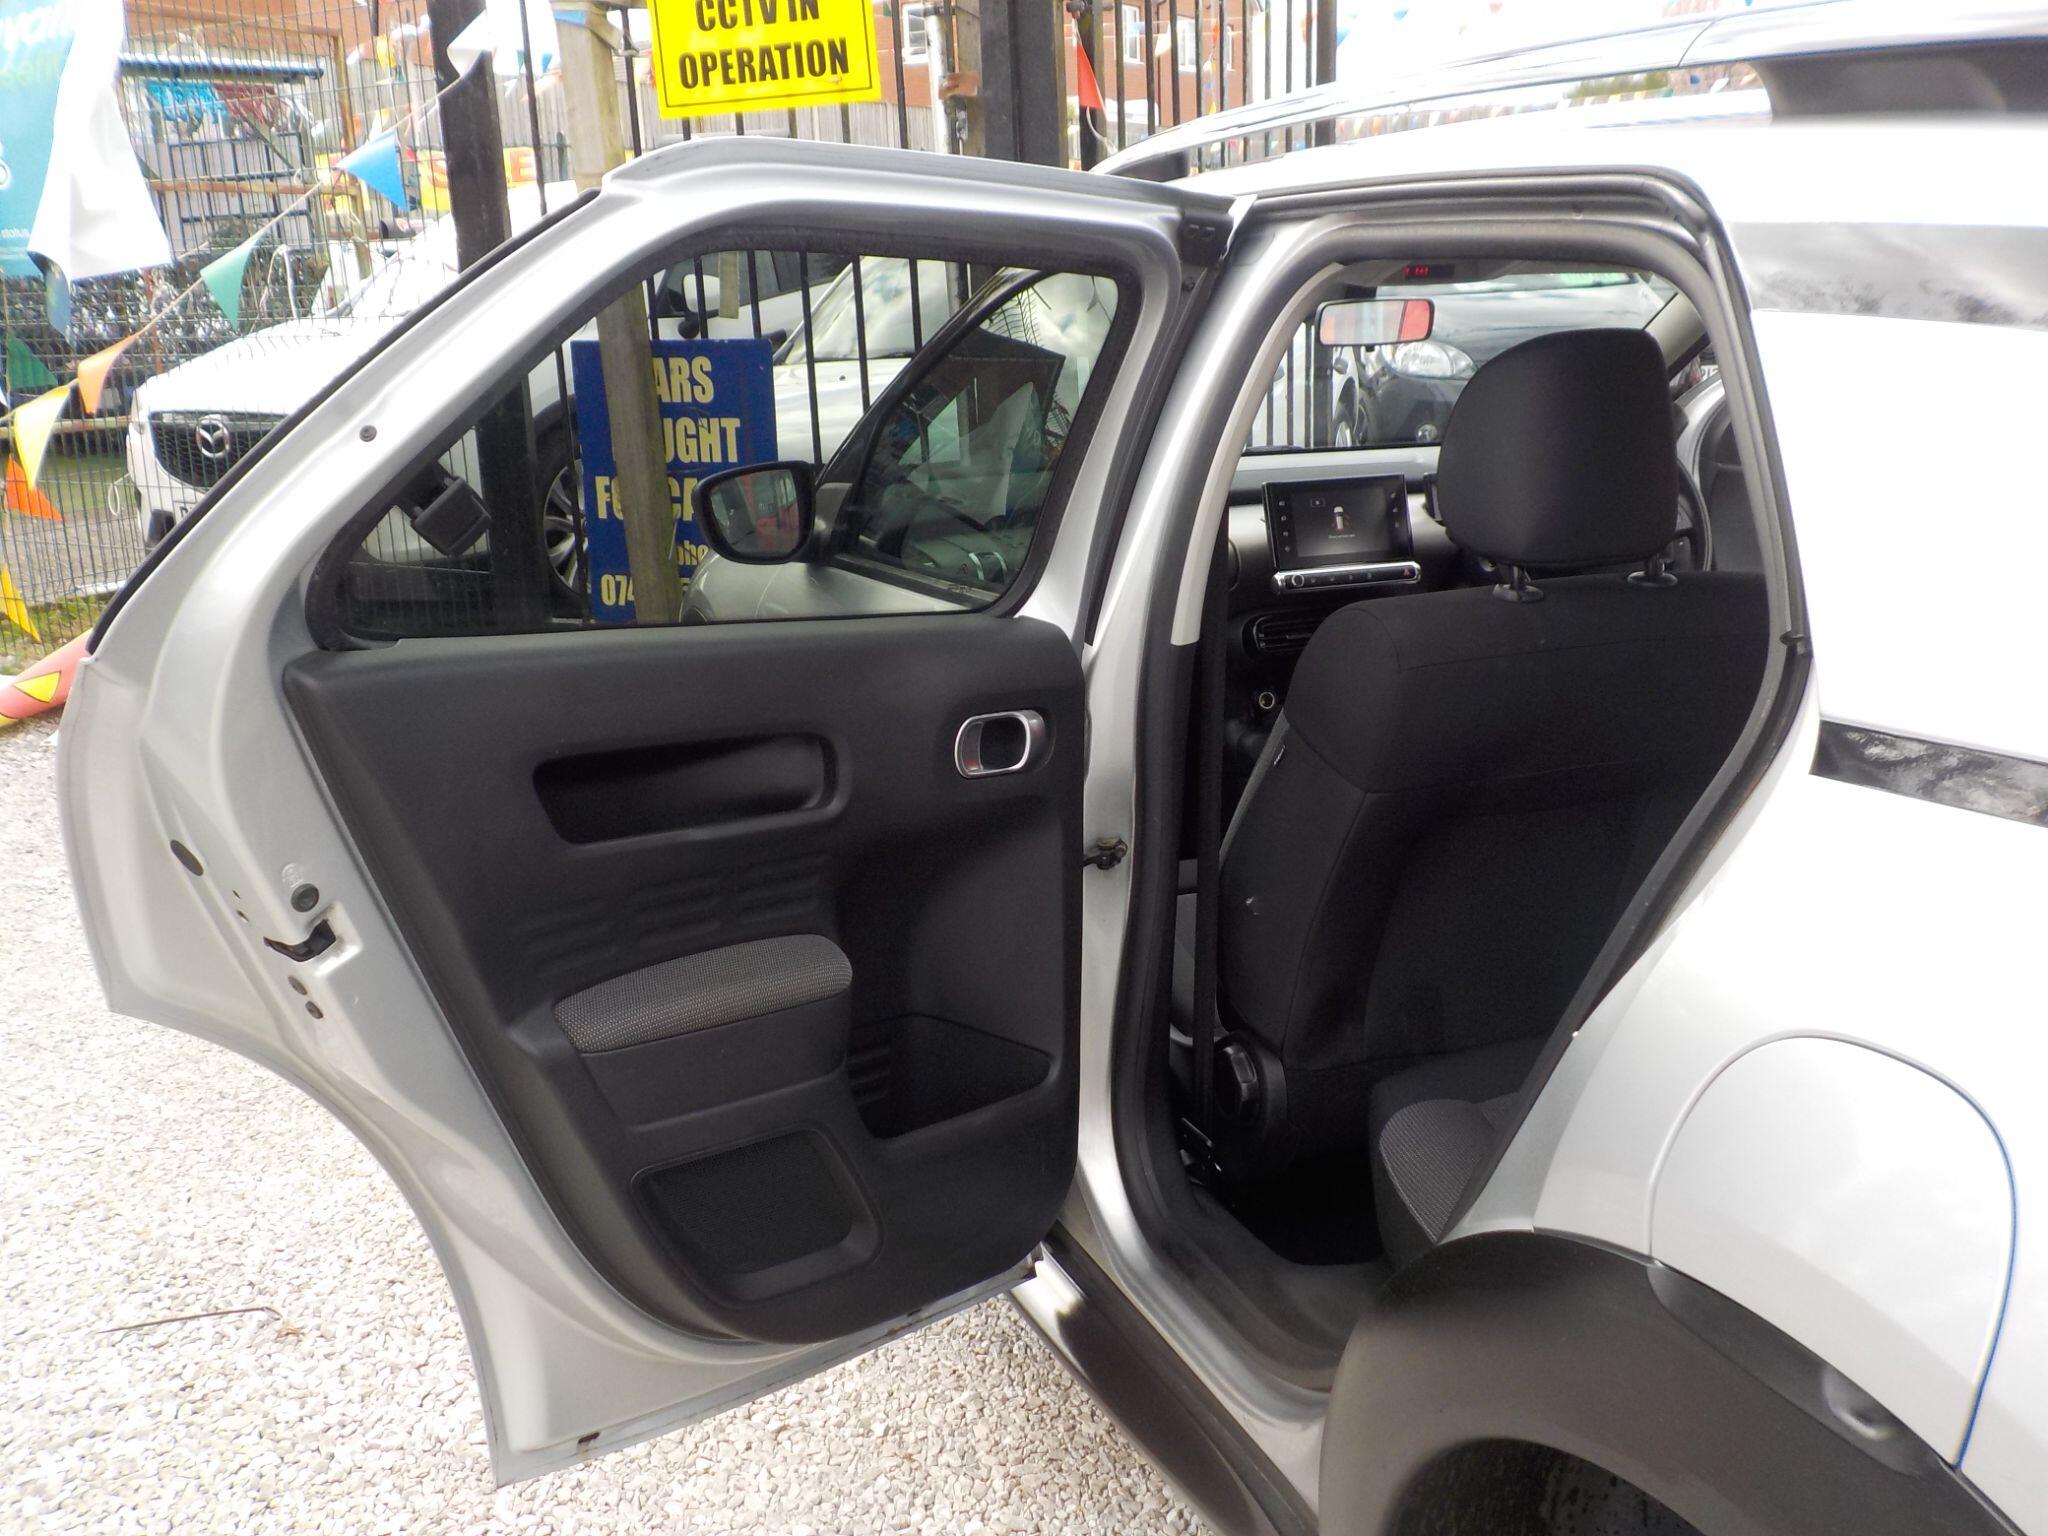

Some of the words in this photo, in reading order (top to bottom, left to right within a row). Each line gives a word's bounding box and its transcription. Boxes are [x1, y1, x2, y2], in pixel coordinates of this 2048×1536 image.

[695, 0, 777, 32] CCTV
[787, 0, 820, 22] IN
[678, 37, 850, 89] OPERATION
[652, 355, 715, 404] ARS
